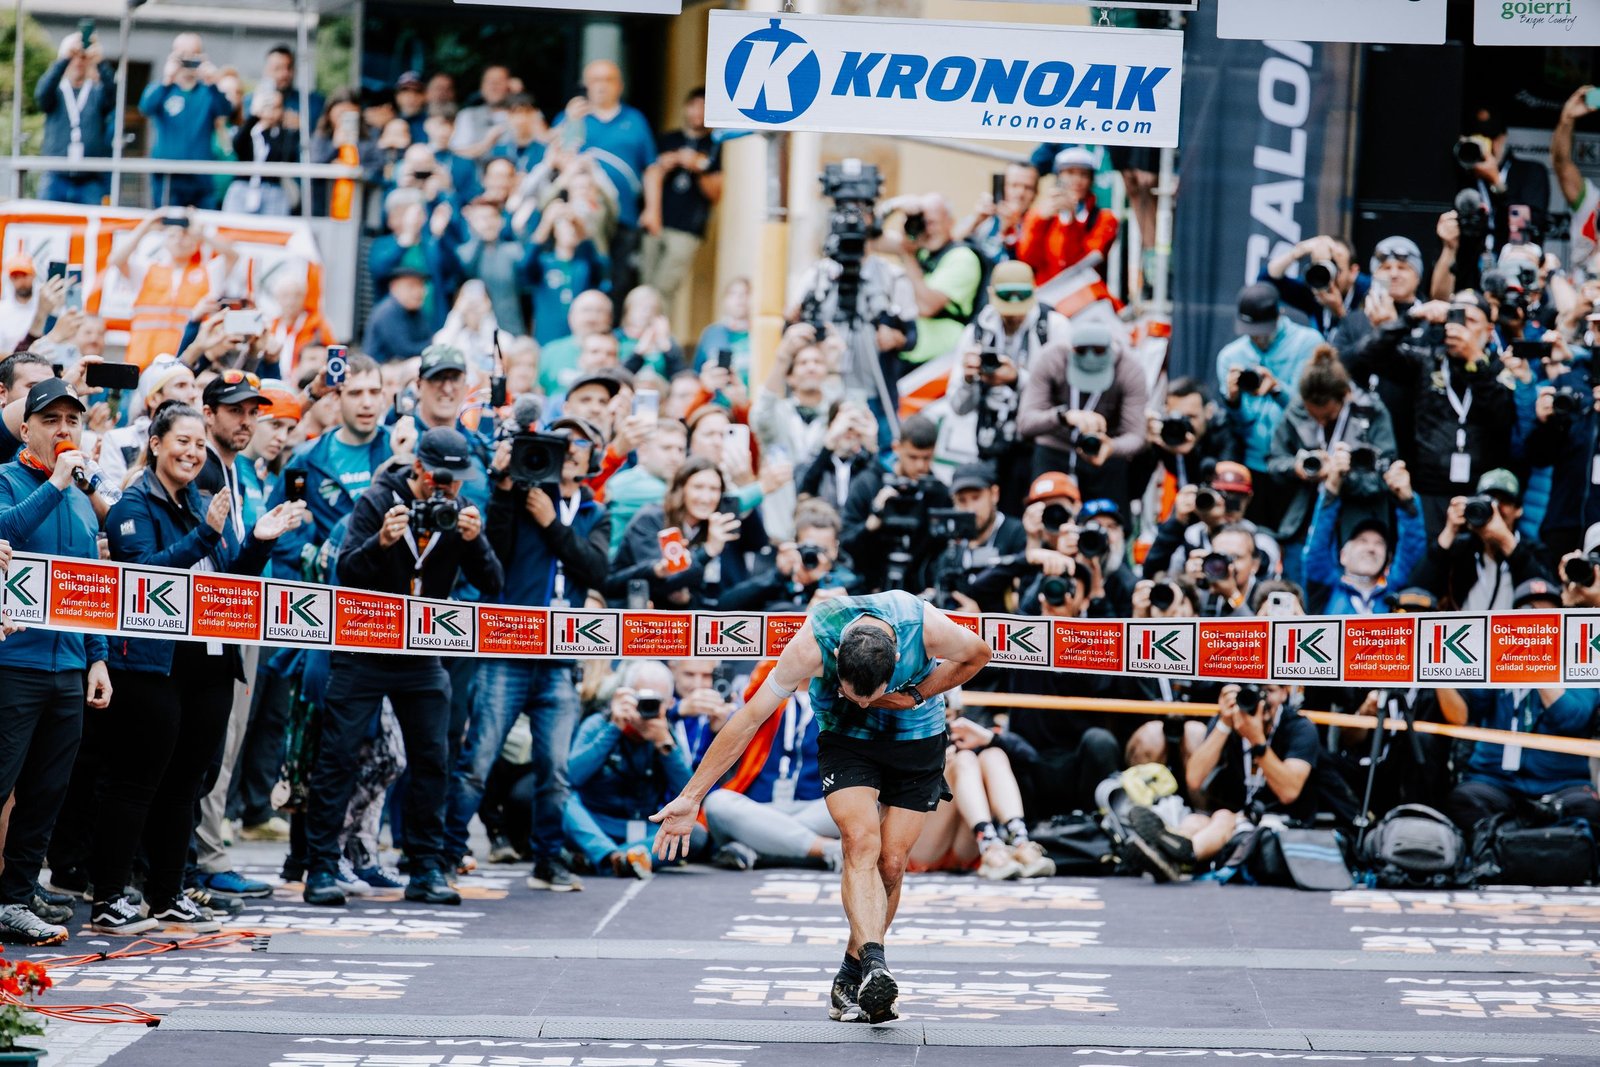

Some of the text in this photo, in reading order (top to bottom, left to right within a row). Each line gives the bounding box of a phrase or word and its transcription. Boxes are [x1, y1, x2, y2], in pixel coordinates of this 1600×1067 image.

[1501, 0, 1571, 19] goierri
[1519, 14, 1577, 31] Basque Country
[831, 51, 1171, 112] KRONOAK
[982, 111, 1152, 134] kronoak.com
[53, 570, 117, 584] Goi-mailako
[59, 582, 111, 594] elikagaiak
[195, 583, 259, 597] Goi-mailako
[61, 598, 110, 609] Alimentos de
[201, 595, 254, 606] elikagaiak
[338, 597, 402, 611] Goi-mailako
[15, 609, 41, 619] LABEL
[55, 608, 115, 619] calidad superior
[203, 610, 241, 619] Alimentos
[344, 607, 396, 618] elikagaiak
[481, 612, 545, 623] Goi-mailako
[125, 616, 184, 629] EUSKO LABEL
[198, 619, 258, 630] calidad superior
[346, 620, 384, 629] Alimentos
[487, 621, 539, 630] elikagaiak
[269, 627, 327, 638] EUSKO LABEL
[1056, 627, 1121, 637] Goi-mailako
[1347, 627, 1412, 637] Goi-mailako
[1493, 624, 1559, 634] Goi-mailako
[341, 629, 400, 640] calidad superior
[490, 631, 528, 639] Alimentos
[1202, 630, 1266, 639] Goi-mailako
[412, 636, 471, 647] EUSKO LABEL
[1062, 636, 1115, 645] elikagaiak
[1207, 640, 1261, 650] elikagaiak
[1352, 637, 1406, 648] elikagaiak
[1498, 636, 1552, 647] elikagaiak
[1020, 655, 1046, 663] LABEL
[1355, 653, 1394, 661] Alimentos
[1501, 653, 1551, 661] Alimentos de
[1131, 661, 1190, 671] EUSKO LABEL
[1204, 661, 1264, 670] calidad superior
[1350, 662, 1411, 671] calidad superior
[1496, 663, 1557, 672] calidad superior
[1276, 667, 1336, 675] EUSKO LABEL
[1422, 668, 1482, 677] EUSKO LABEL
[1568, 668, 1599, 677] EUSKO
